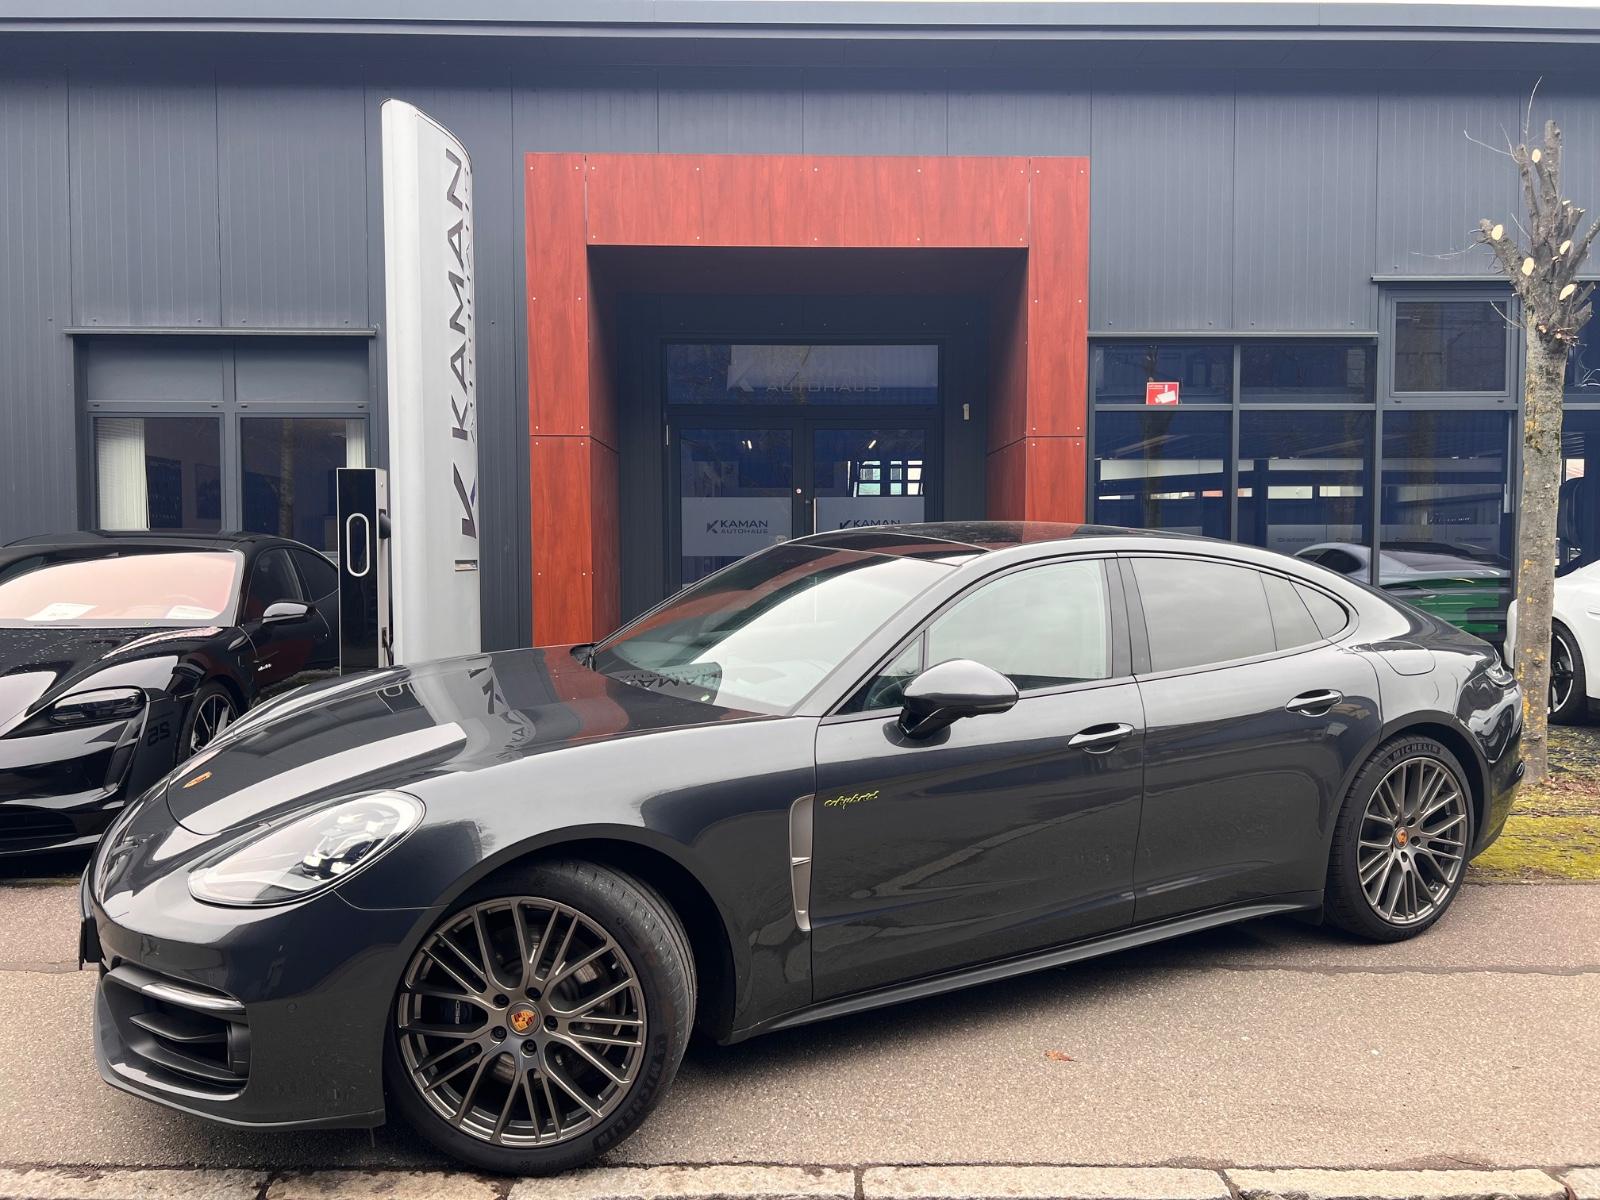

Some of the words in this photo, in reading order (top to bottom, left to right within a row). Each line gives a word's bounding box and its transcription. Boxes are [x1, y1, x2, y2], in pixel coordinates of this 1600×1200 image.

[446, 148, 469, 441] KAMAN
[766, 381, 881, 393] AUTOHAUS
[720, 519, 768, 528] KAMAN
[853, 519, 900, 527] KAMAN
[1392, 743, 1440, 760] MICHELIN
[597, 1060, 663, 1147] MICHELIN
